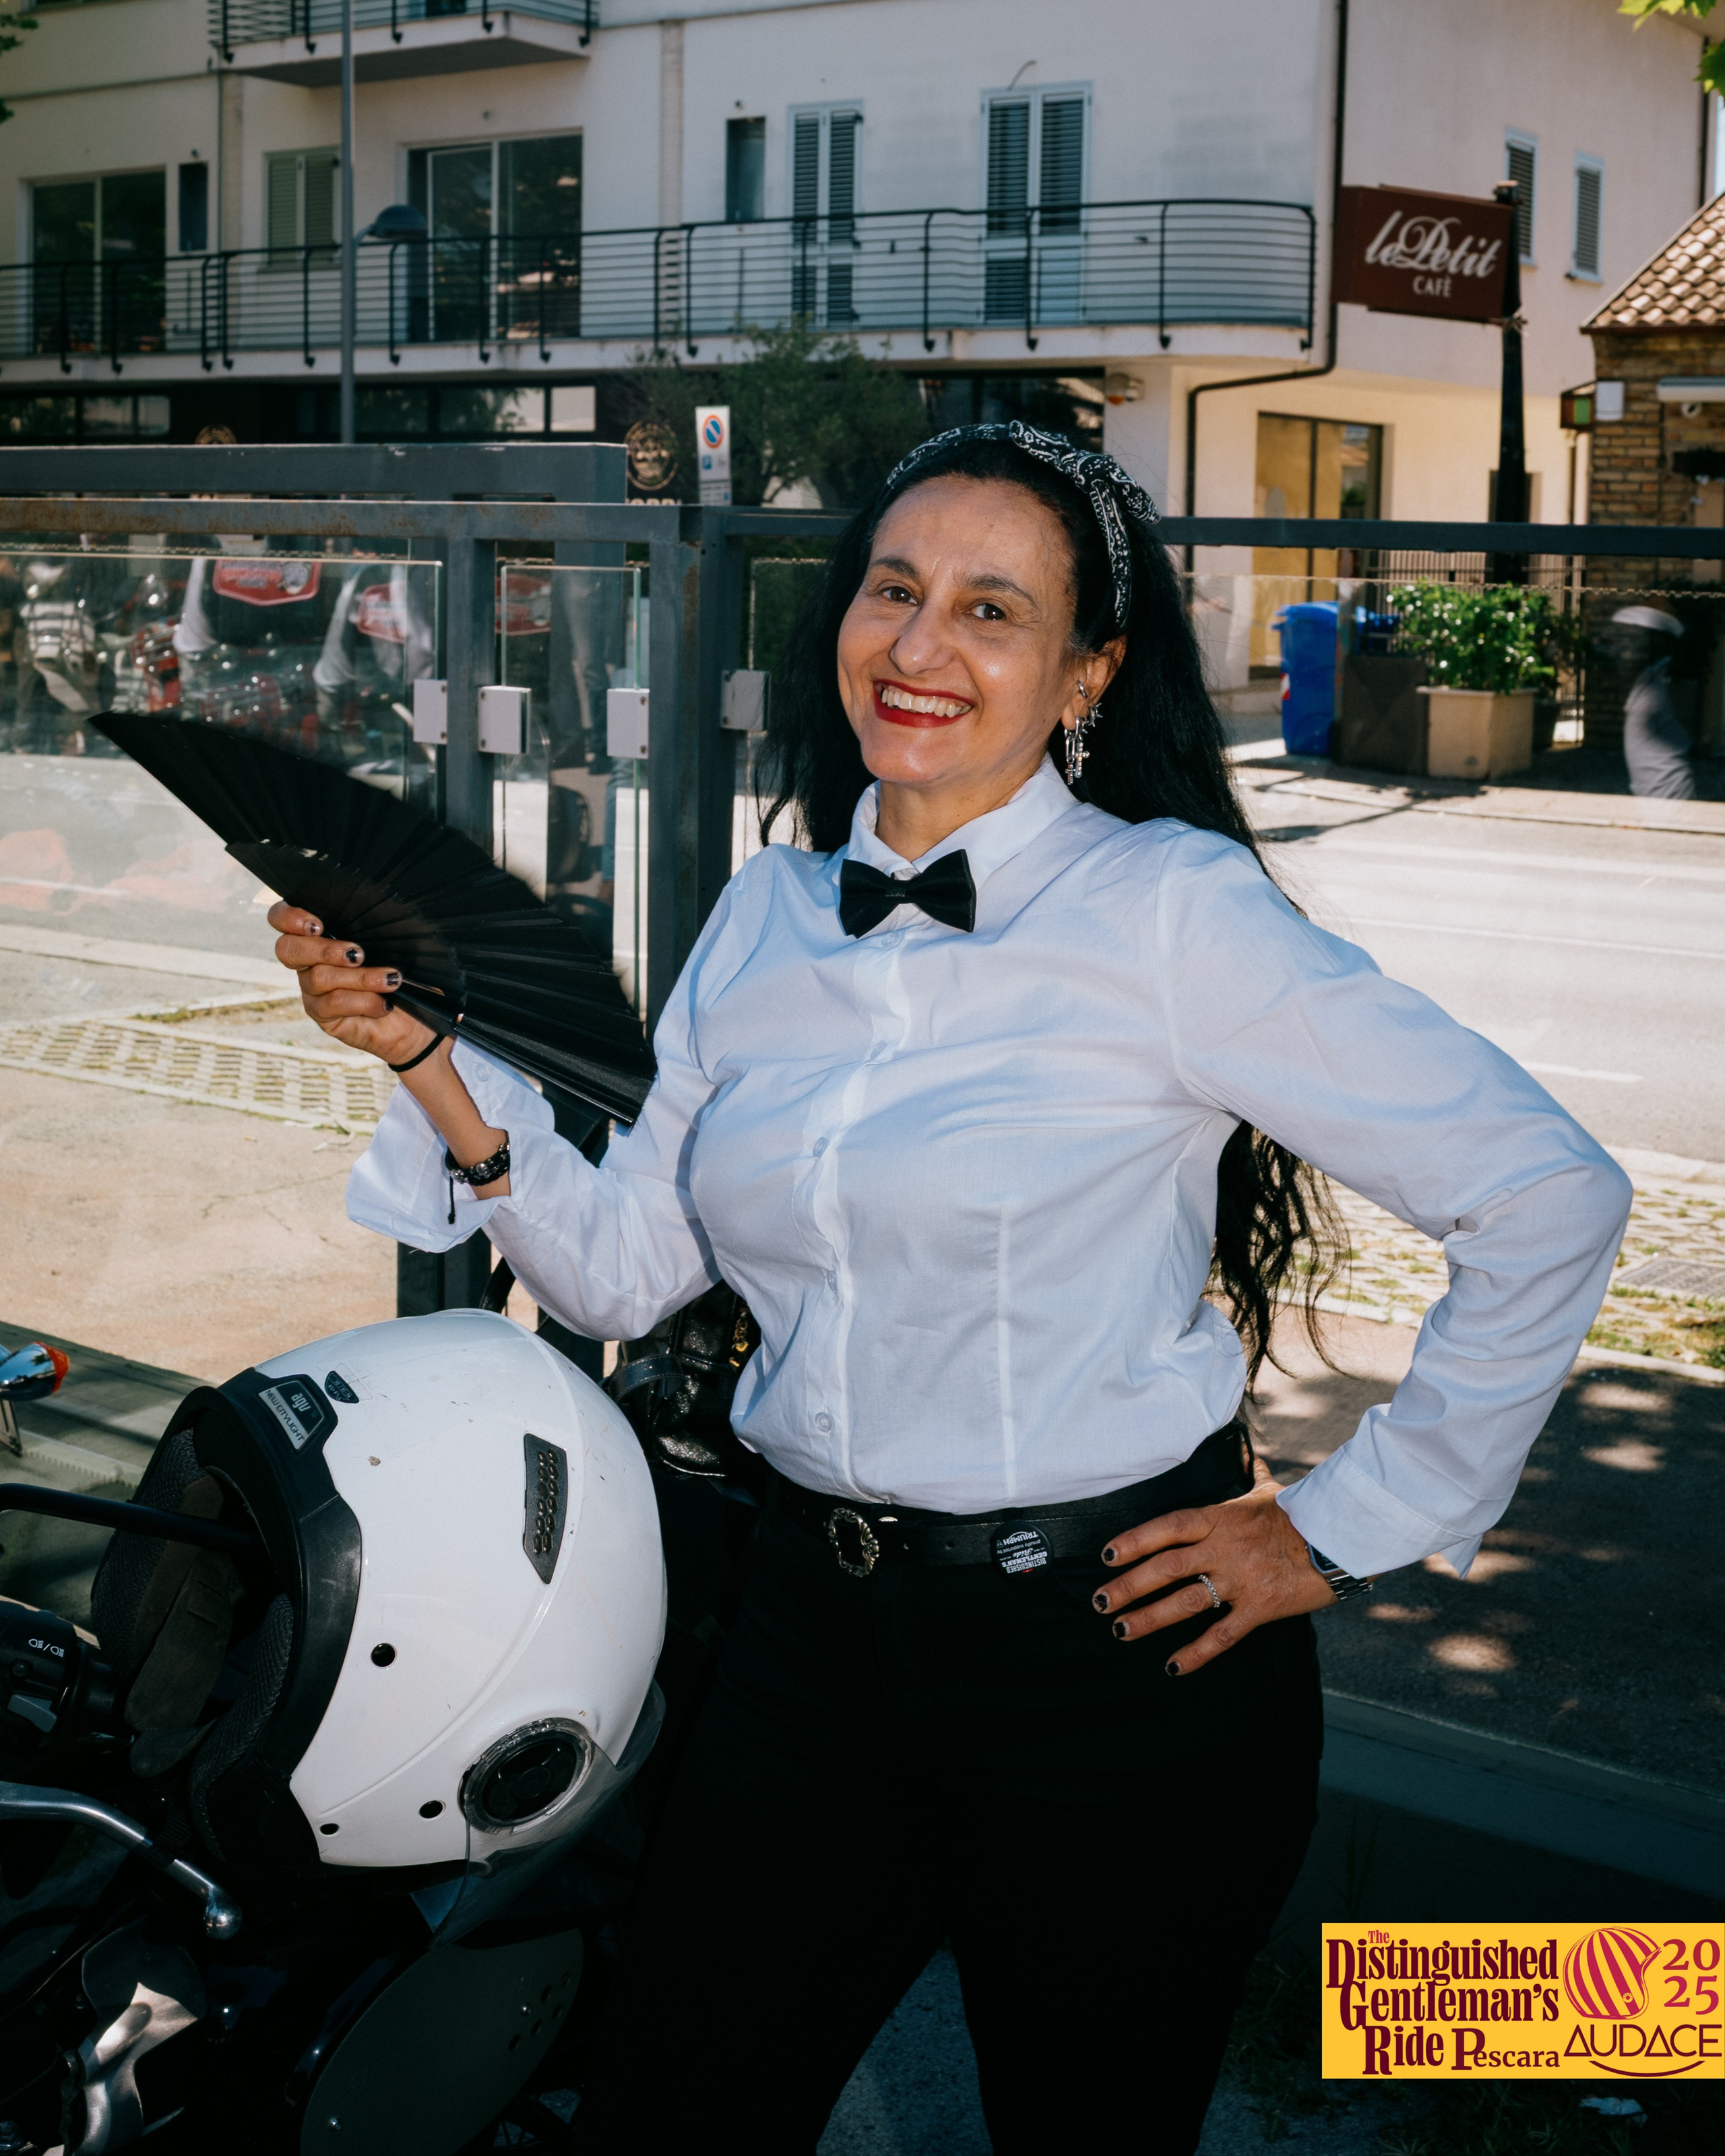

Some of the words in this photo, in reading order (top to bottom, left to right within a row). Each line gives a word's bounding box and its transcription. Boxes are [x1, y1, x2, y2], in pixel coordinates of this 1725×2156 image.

[1392, 215, 1503, 278] Petit
[265, 1389, 279, 1405] NEW
[276, 1403, 306, 1441] CITYLIGHT
[1003, 1531, 1038, 1545] TRIUMPH
[1003, 1544, 1024, 1553] supported
[1013, 1548, 1034, 1558] Ride
[1002, 1552, 1047, 1567] GENTLEMAN'S
[1007, 1558, 1046, 1573] DISTINGUISHED
